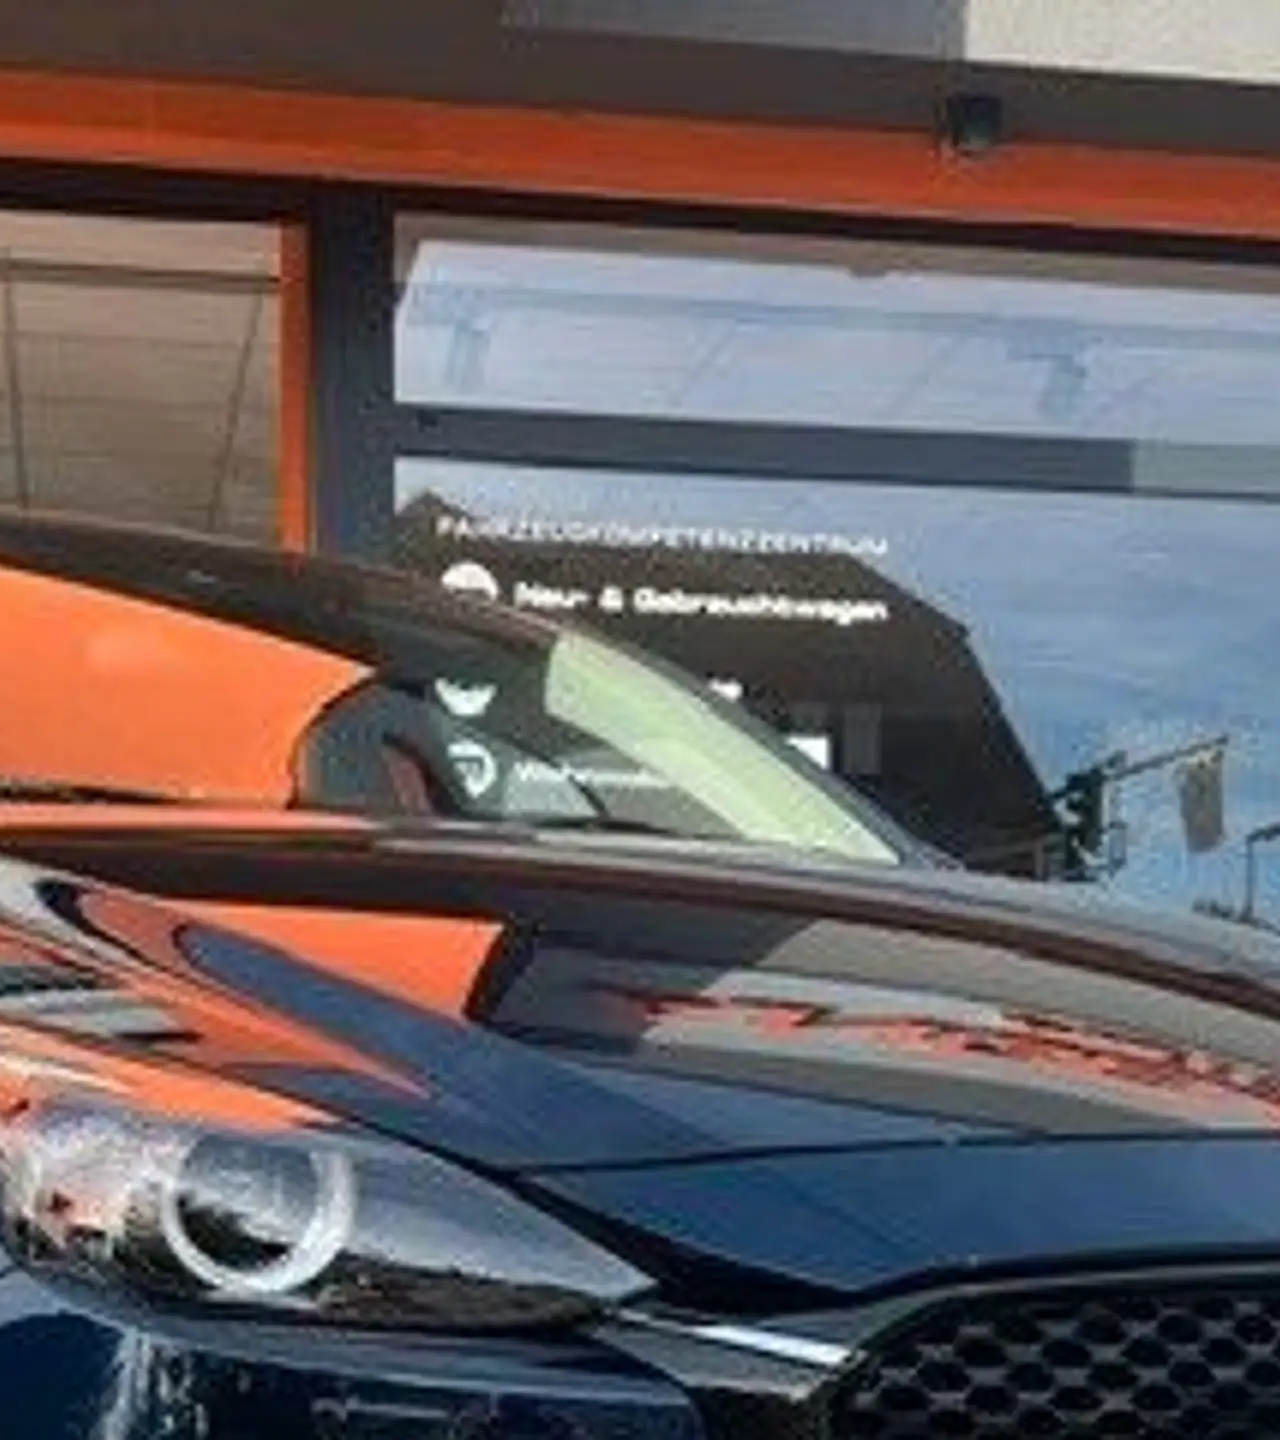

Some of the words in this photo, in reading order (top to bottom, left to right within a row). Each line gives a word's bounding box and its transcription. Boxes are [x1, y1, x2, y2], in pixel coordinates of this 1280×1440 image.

[514, 580, 590, 609] Neu-
[597, 584, 623, 614] &
[634, 586, 890, 626] Gebrauchtwagen
